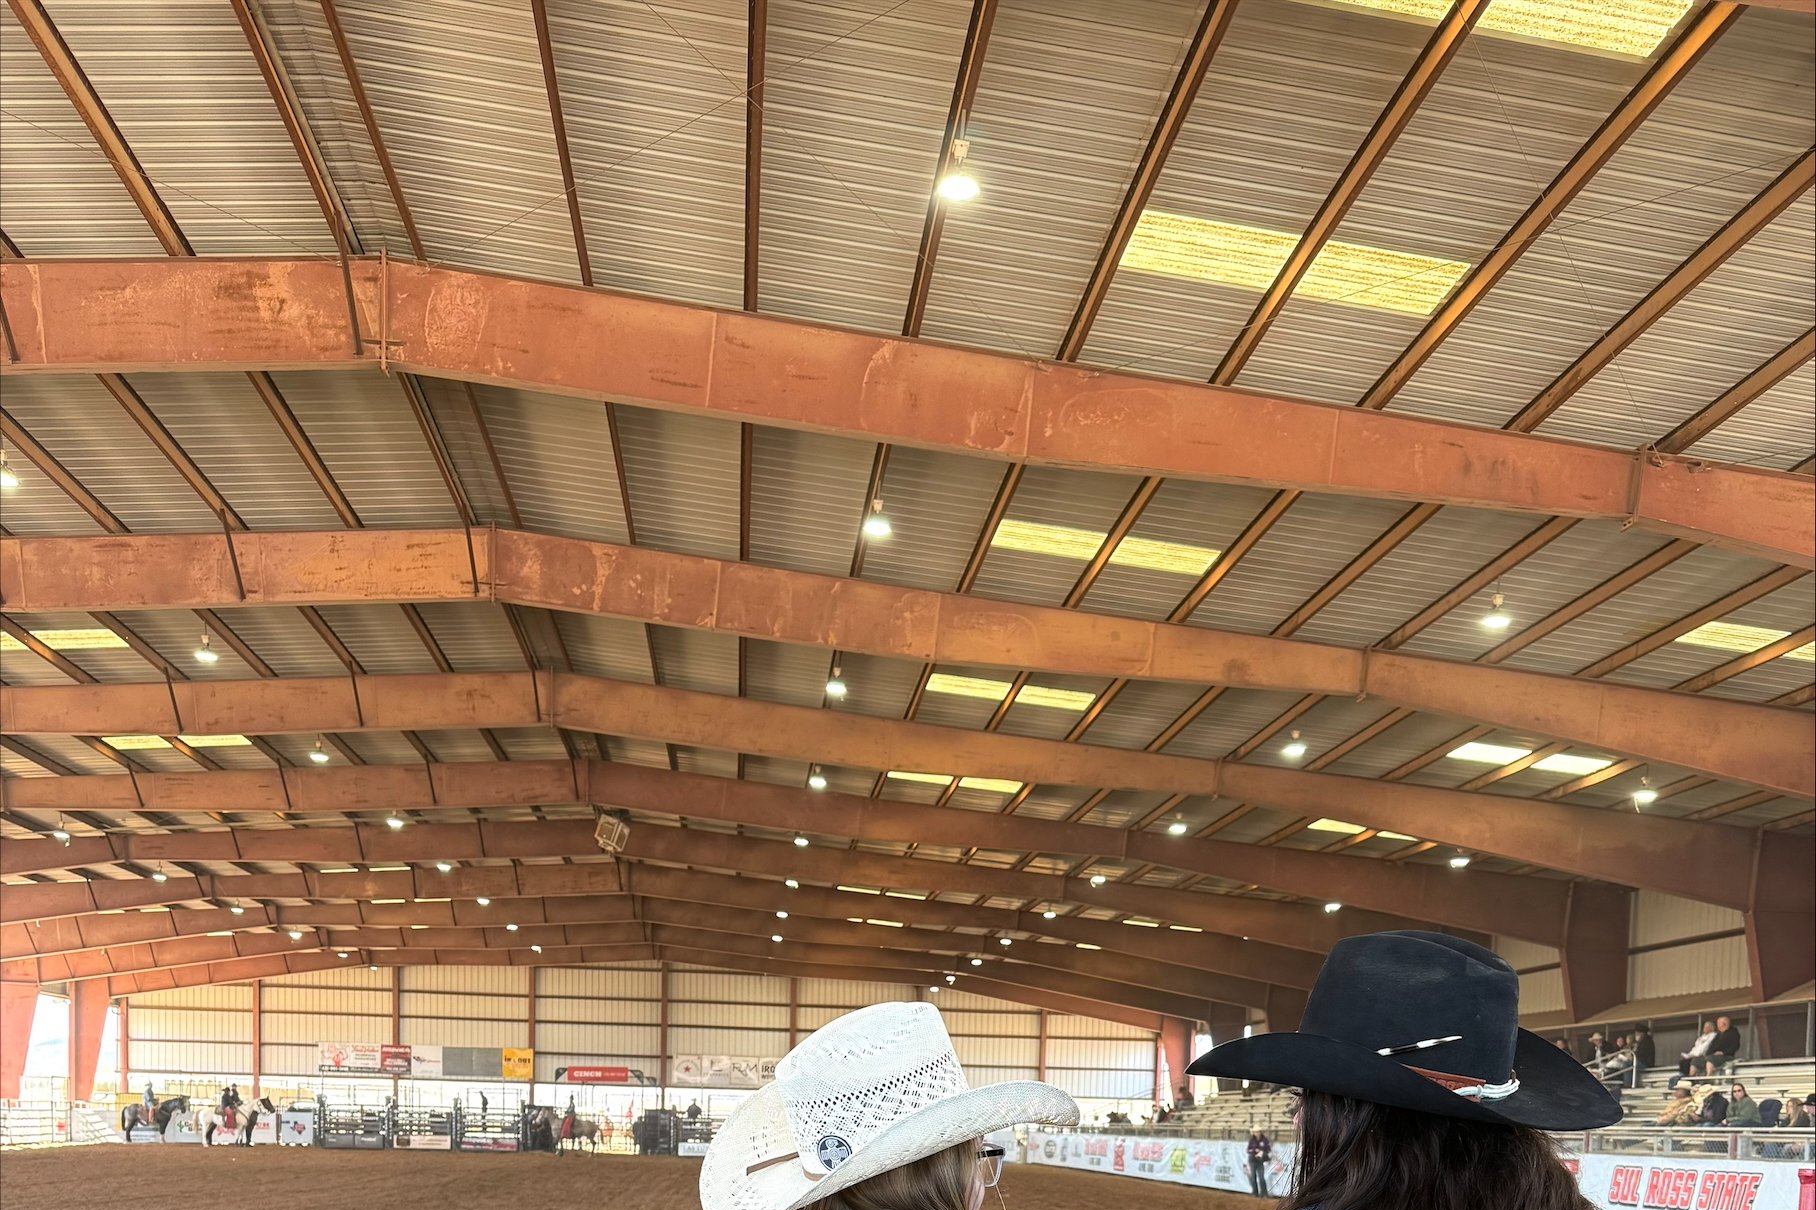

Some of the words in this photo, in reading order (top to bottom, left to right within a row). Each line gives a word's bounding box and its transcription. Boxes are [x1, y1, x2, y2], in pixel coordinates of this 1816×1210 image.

[573, 1070, 602, 1078] CINCH
[761, 1065, 776, 1074] IRO
[1608, 1164, 1643, 1206] SUL
